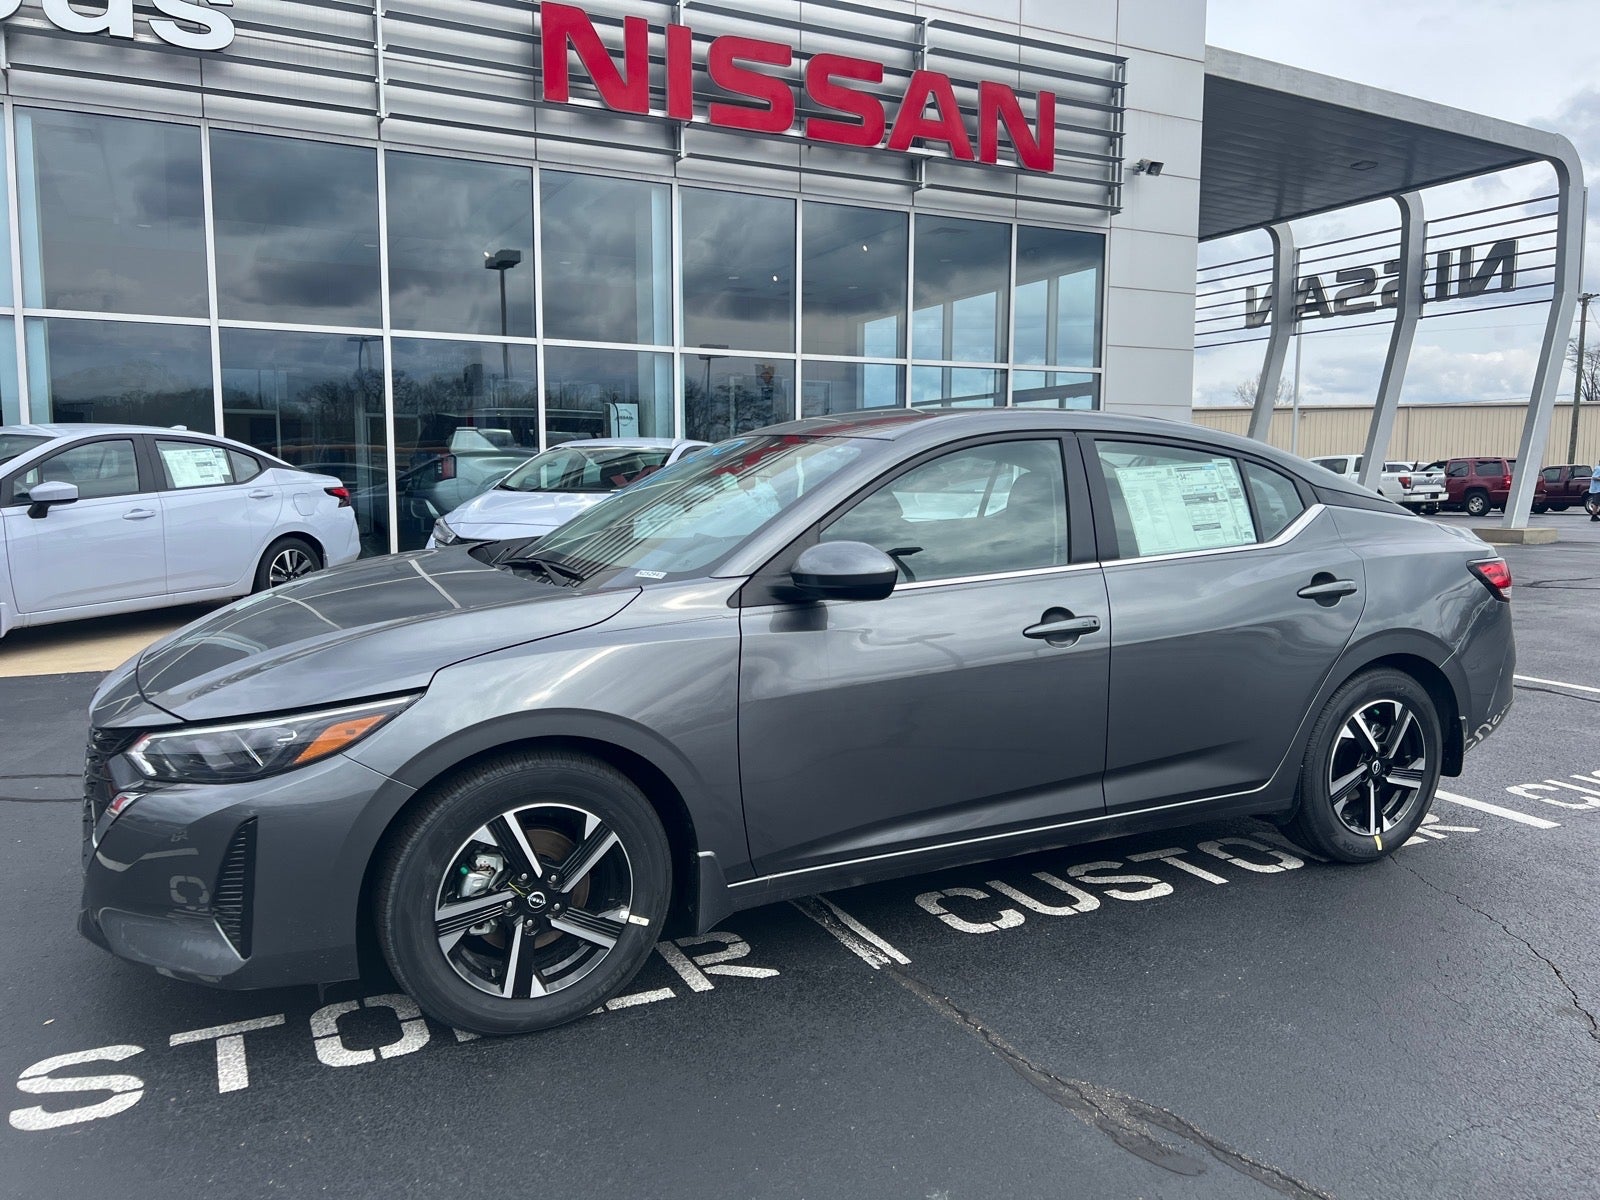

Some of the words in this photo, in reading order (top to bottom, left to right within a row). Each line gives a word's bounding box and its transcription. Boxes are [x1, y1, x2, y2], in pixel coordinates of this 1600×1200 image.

[540, 1, 1056, 172] NISSAN
[914, 813, 1481, 934] CUSTOR
[9, 932, 780, 1131] STOR
